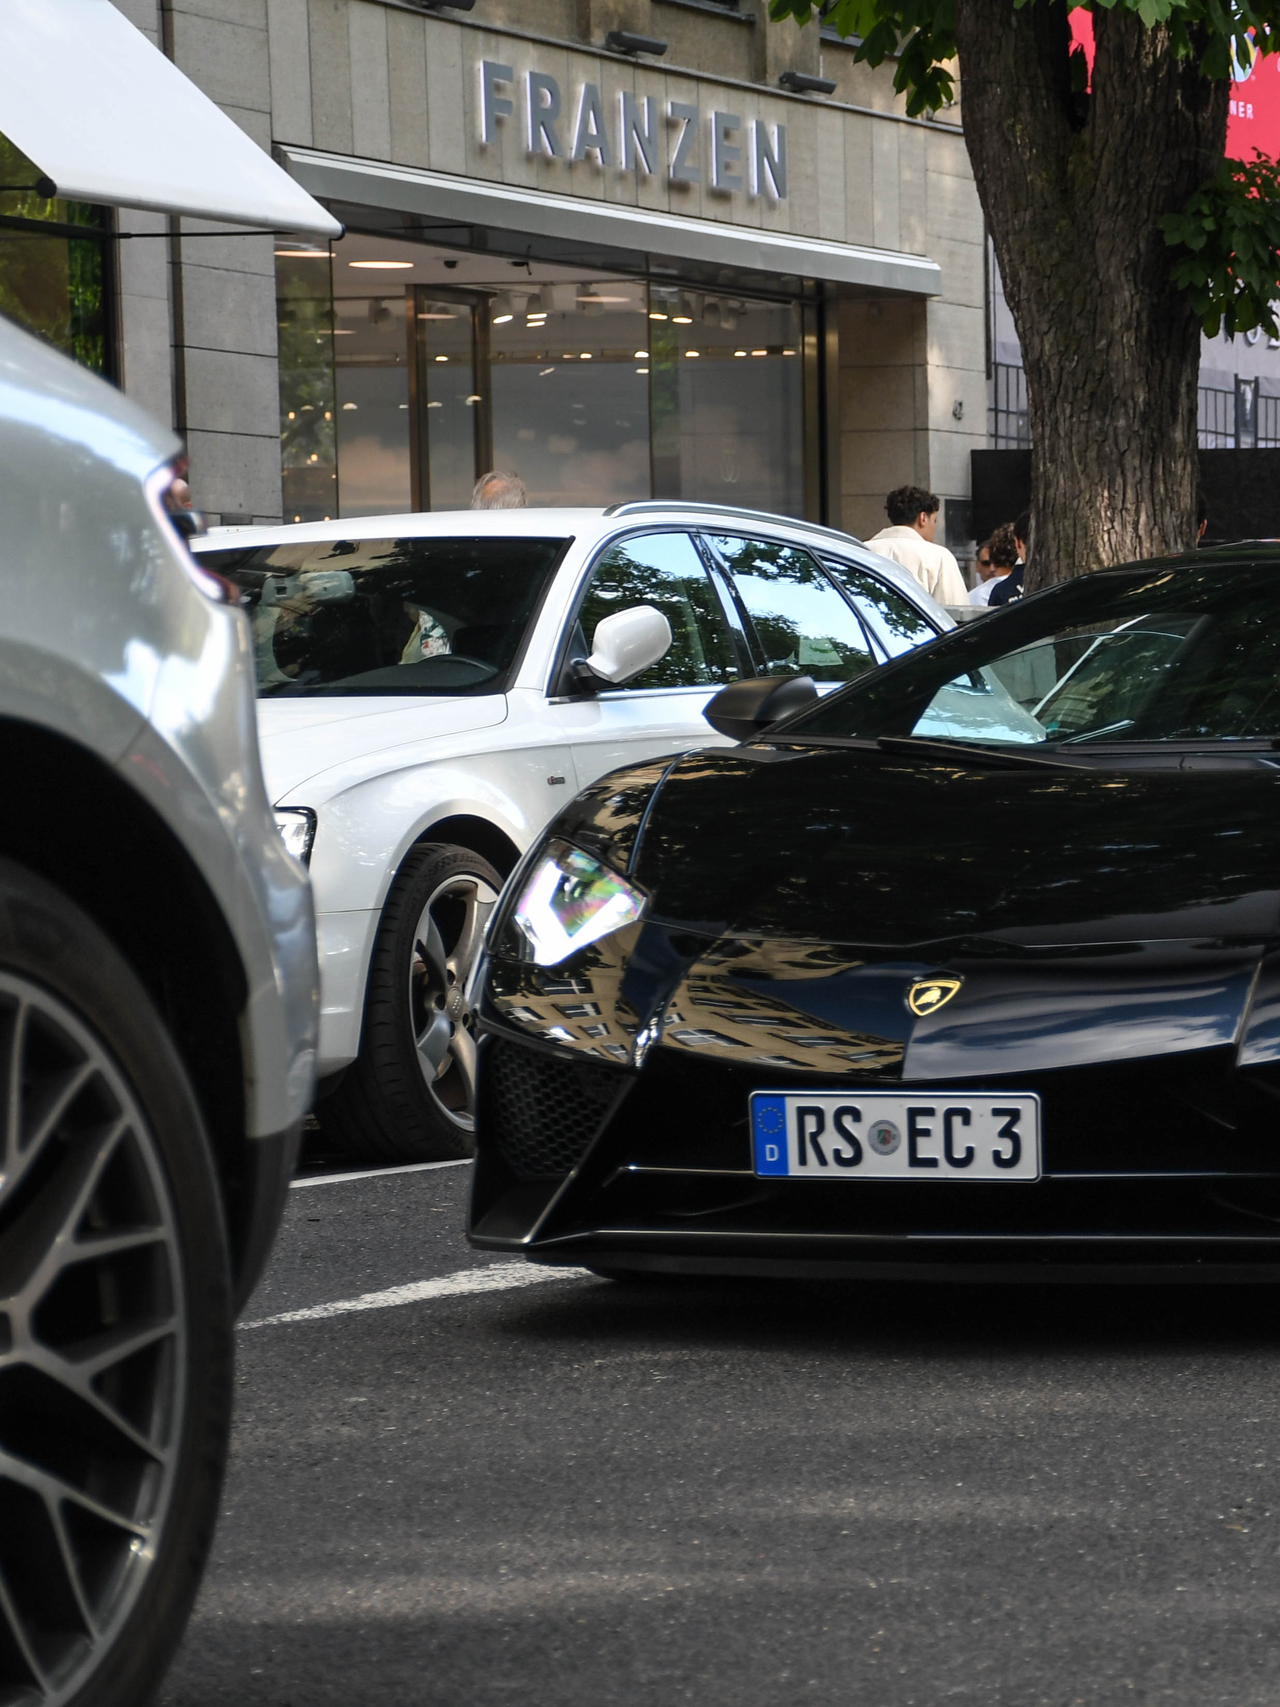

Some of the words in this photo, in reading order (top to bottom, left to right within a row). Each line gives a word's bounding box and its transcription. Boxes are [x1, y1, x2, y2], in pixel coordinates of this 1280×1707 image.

[480, 60, 787, 199] FRANZEN
[1229, 99, 1254, 119] NER
[765, 1144, 779, 1162] D
[796, 1105, 863, 1167] RS
[907, 1106, 975, 1168] EC
[990, 1106, 1022, 1168] 3
